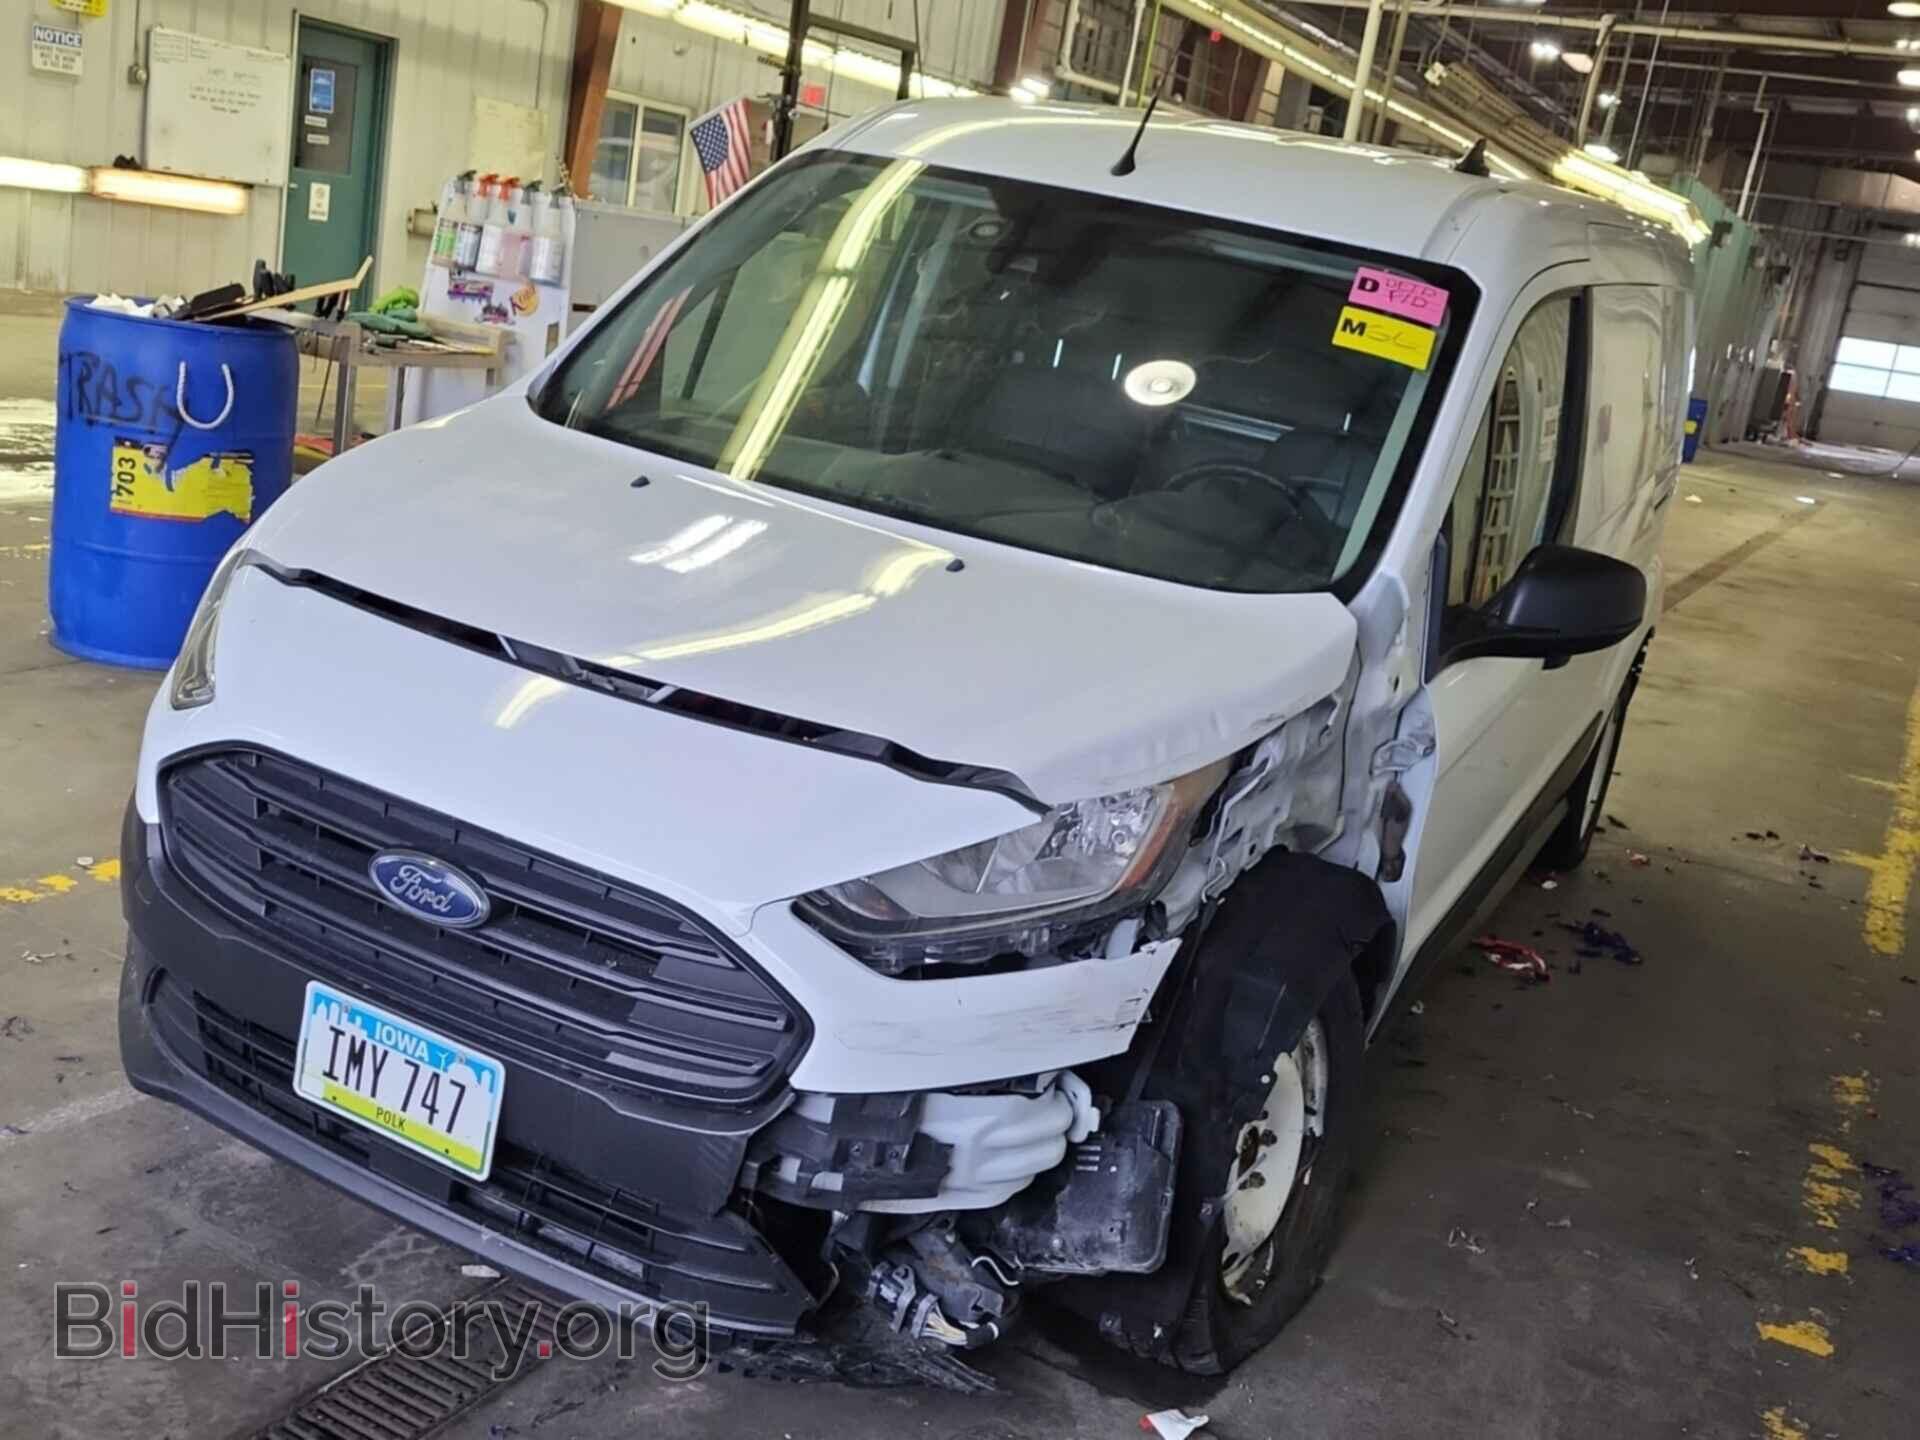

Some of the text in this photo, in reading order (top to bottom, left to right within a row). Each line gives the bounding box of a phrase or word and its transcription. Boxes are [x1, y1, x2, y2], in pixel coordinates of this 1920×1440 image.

[35, 27, 81, 47] NOTICE
[1358, 277, 1380, 293] D
[1341, 317, 1367, 337] M
[390, 864, 457, 913] Ford
[375, 1022, 430, 1062] IOWA
[322, 1025, 467, 1134] IMY 747
[375, 1106, 406, 1131] POLK
